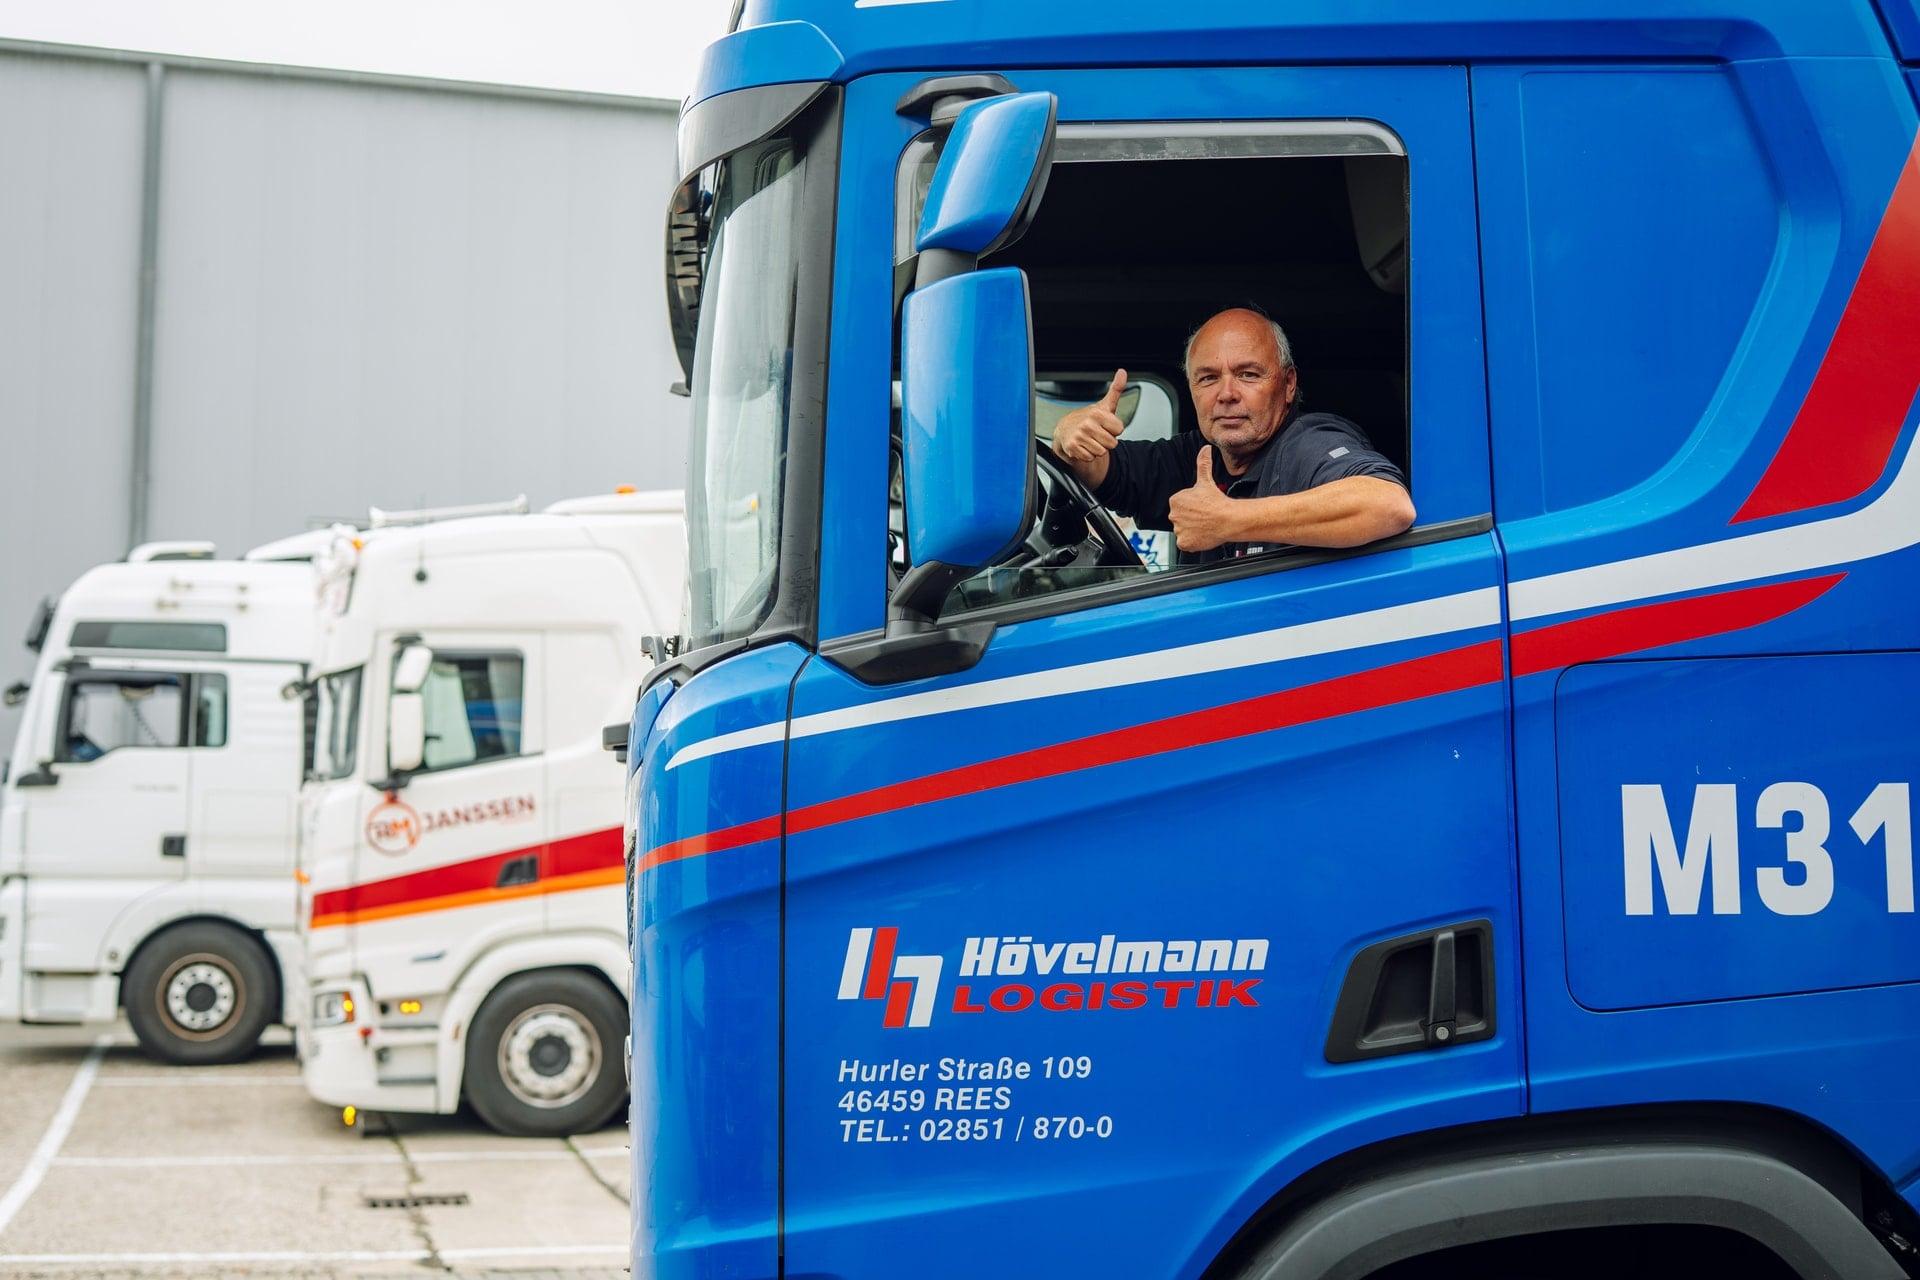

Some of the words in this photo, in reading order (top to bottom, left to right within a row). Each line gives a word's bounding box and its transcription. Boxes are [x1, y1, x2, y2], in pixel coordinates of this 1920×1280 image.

[423, 796, 535, 832] JANSSEN
[1621, 781, 1915, 916] M31
[958, 935, 1269, 976] Hövelmann
[952, 979, 1264, 1013] LOGISTIK
[838, 1060, 929, 1082] Hurler
[937, 1057, 1031, 1081] Straße
[1042, 1056, 1092, 1079] 109
[838, 1089, 925, 1113] 46459
[934, 1086, 1012, 1111] REES
[840, 1119, 910, 1143] TEL.:
[919, 1117, 1003, 1142] 02851
[1015, 1116, 1025, 1142] /
[1033, 1115, 1113, 1139] 870-0
